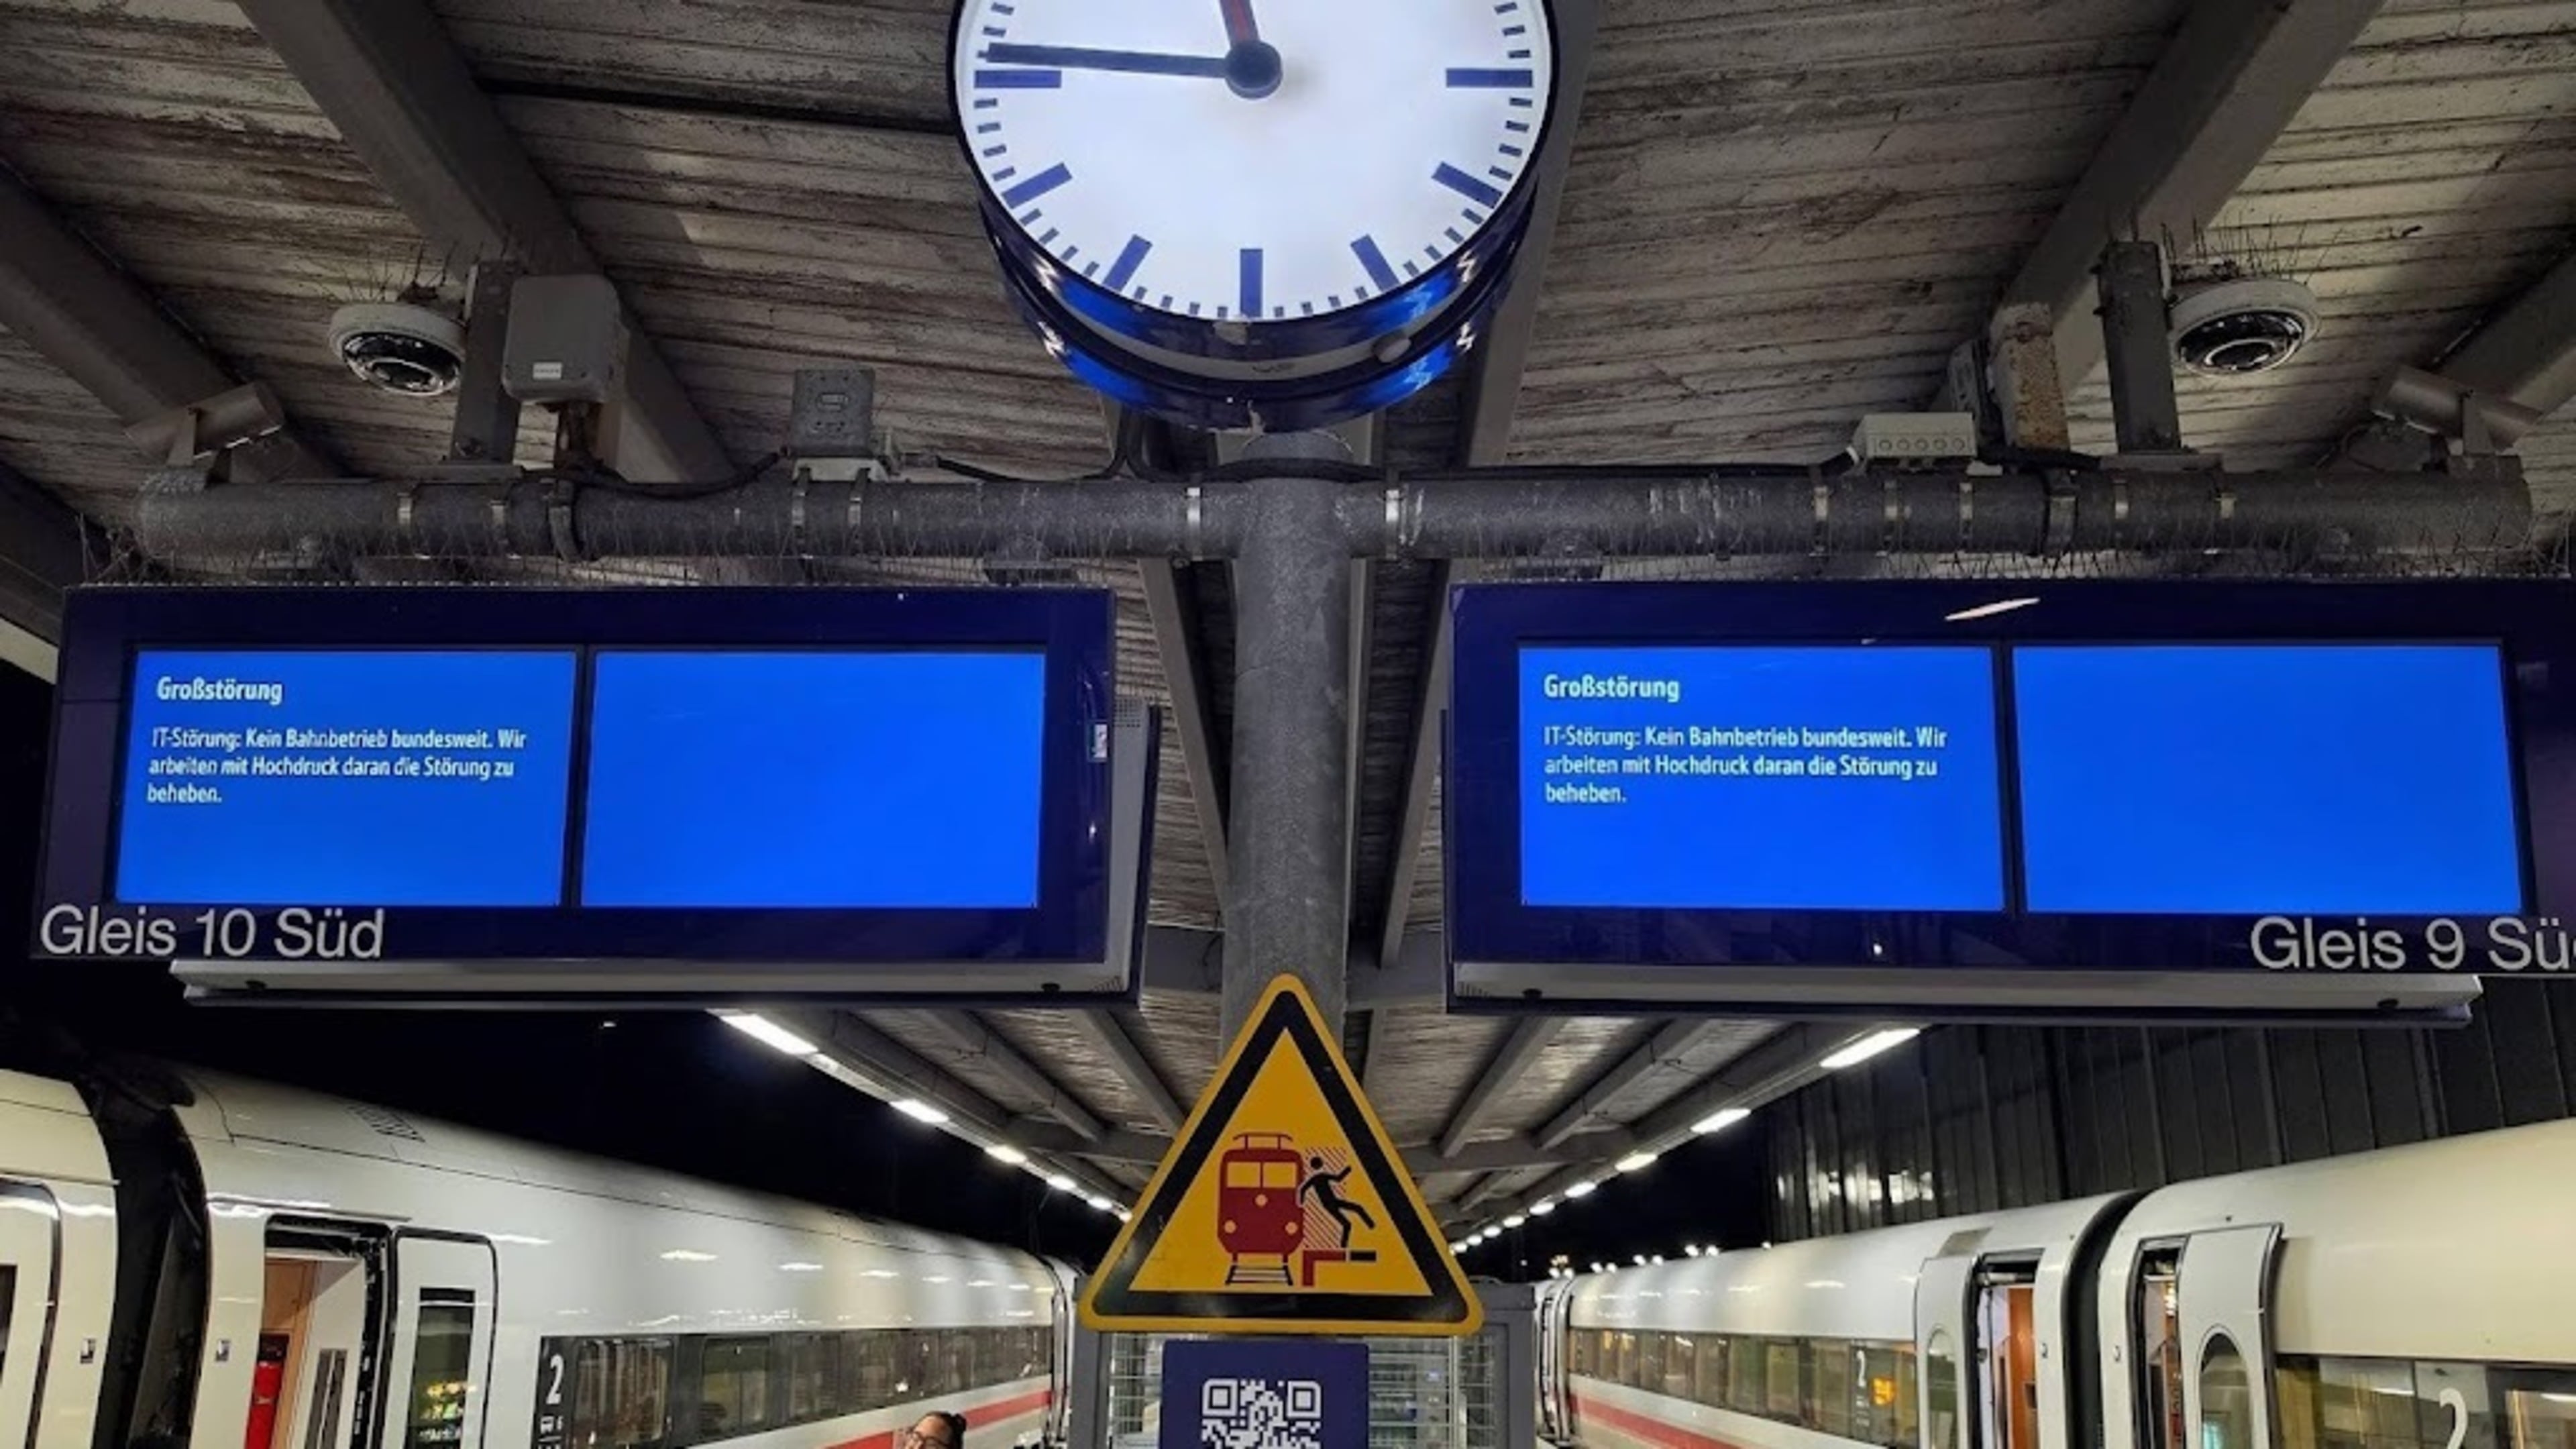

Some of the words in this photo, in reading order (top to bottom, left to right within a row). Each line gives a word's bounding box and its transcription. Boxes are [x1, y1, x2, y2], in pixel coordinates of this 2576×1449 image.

[157, 676, 283, 705] Großstörung
[1544, 674, 1680, 702] Großstörung
[153, 727, 242, 752] IT-Störung:
[246, 729, 282, 748] Kein
[286, 729, 388, 748] Bahnbetrieb
[391, 729, 493, 749] bundesweit.
[497, 729, 527, 749] Wir
[1544, 725, 1641, 749] IT-Störung:
[1645, 727, 1684, 746] Kein
[1689, 726, 1799, 747] Bahnbetrieb
[1803, 727, 1912, 747] bundesweit.
[1915, 727, 1947, 747] Wir
[149, 757, 217, 775] arbeiten
[221, 757, 248, 775] mit
[252, 756, 339, 776] Hochdruck
[342, 757, 390, 776] daran
[394, 757, 421, 777] die
[423, 757, 490, 780] Störung
[493, 762, 514, 777] zu
[1545, 755, 1618, 774] arbeiten
[1622, 756, 1651, 774] mit
[1654, 755, 1749, 775] Hochdruck
[1752, 755, 1805, 775] daran
[1808, 755, 1837, 775] die
[1839, 755, 1912, 780] Störung
[1915, 761, 1937, 776] zu
[147, 783, 222, 803] beheben.
[1546, 783, 1627, 802] beheben.
[40, 904, 177, 955] Gleis
[195, 908, 256, 957] 10
[274, 906, 384, 959] Süd
[2251, 916, 2407, 969] Gleis
[2425, 918, 2465, 969] 9
[2488, 917, 2576, 970] Sü
[545, 1354, 564, 1405] 2
